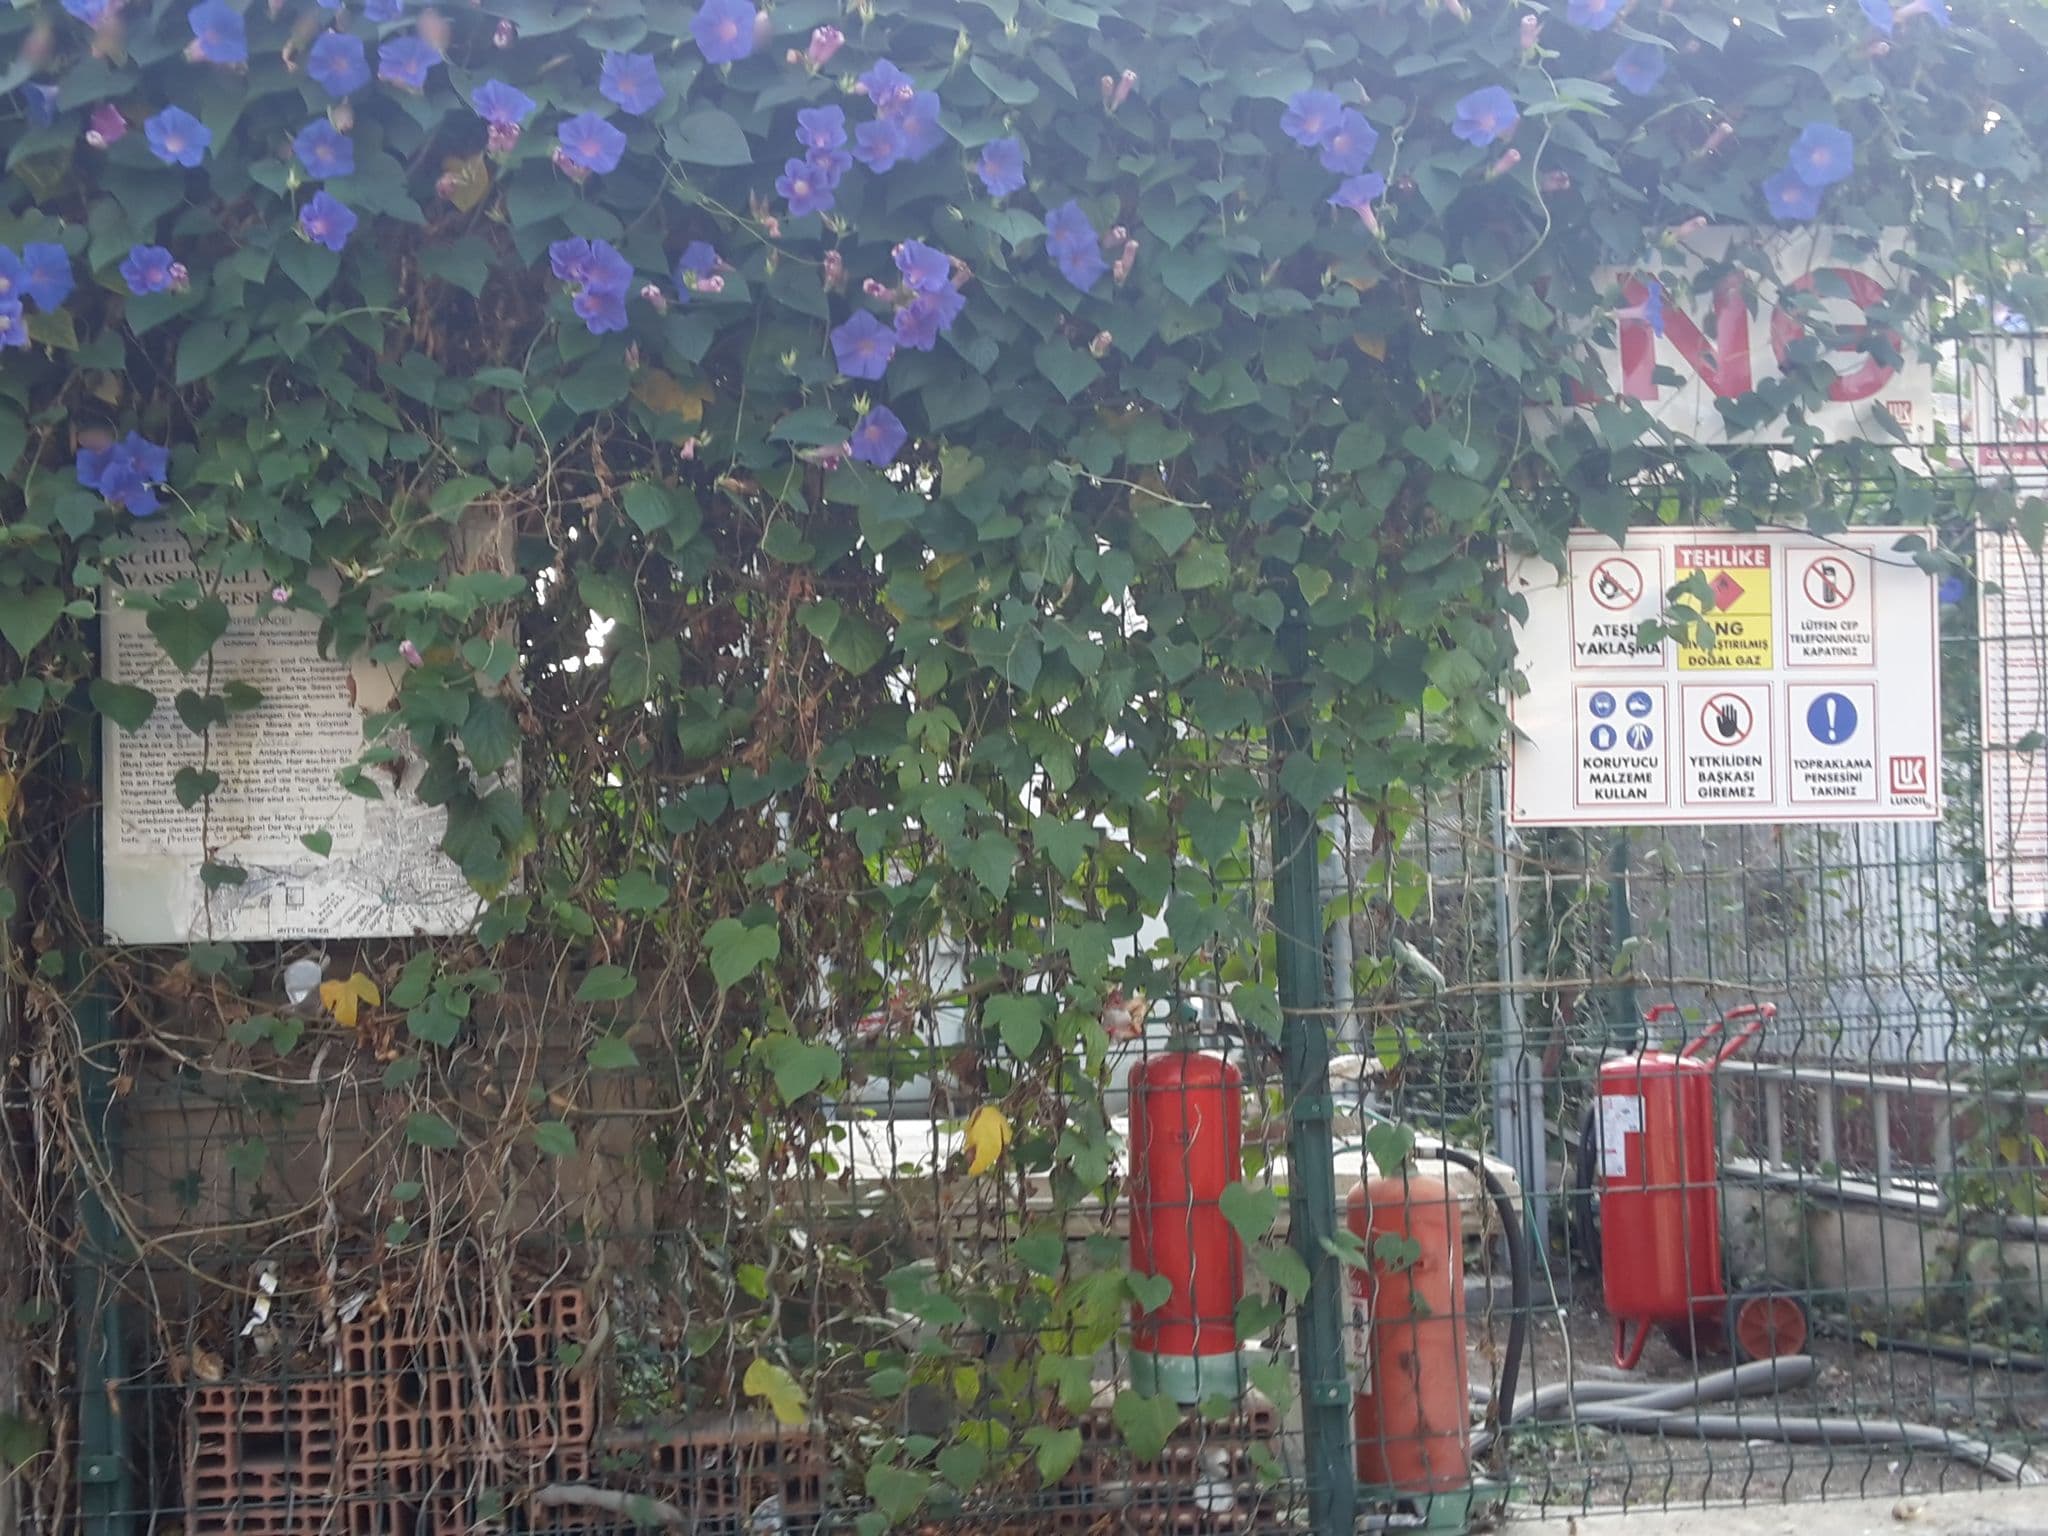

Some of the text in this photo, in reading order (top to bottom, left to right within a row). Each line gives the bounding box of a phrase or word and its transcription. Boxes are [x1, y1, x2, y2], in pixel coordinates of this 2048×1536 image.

[1525, 266, 1902, 402] NG
[1680, 545, 1766, 567] TEHLİKE
[1592, 623, 1641, 640] ATEŞL
[1801, 620, 1858, 630] LÜTFEN CEP
[1790, 634, 1869, 644] TELEFONUNUZU
[1803, 646, 1857, 656] KAPATINIZ
[1735, 654, 1761, 665] GAZ
[1583, 756, 1658, 769] KORUYUCU
[1690, 753, 1762, 767] YETKİLİDEN
[1794, 758, 1872, 770] TOPRAKLAMA
[1590, 772, 1653, 784] MALZEME
[1698, 770, 1755, 785] BAŞKASI
[1805, 770, 1862, 783] PENSESİNİ
[1595, 787, 1648, 800] KULLAN
[1698, 784, 1756, 799] GİREMEZ
[1811, 786, 1857, 797] TAKINIZ
